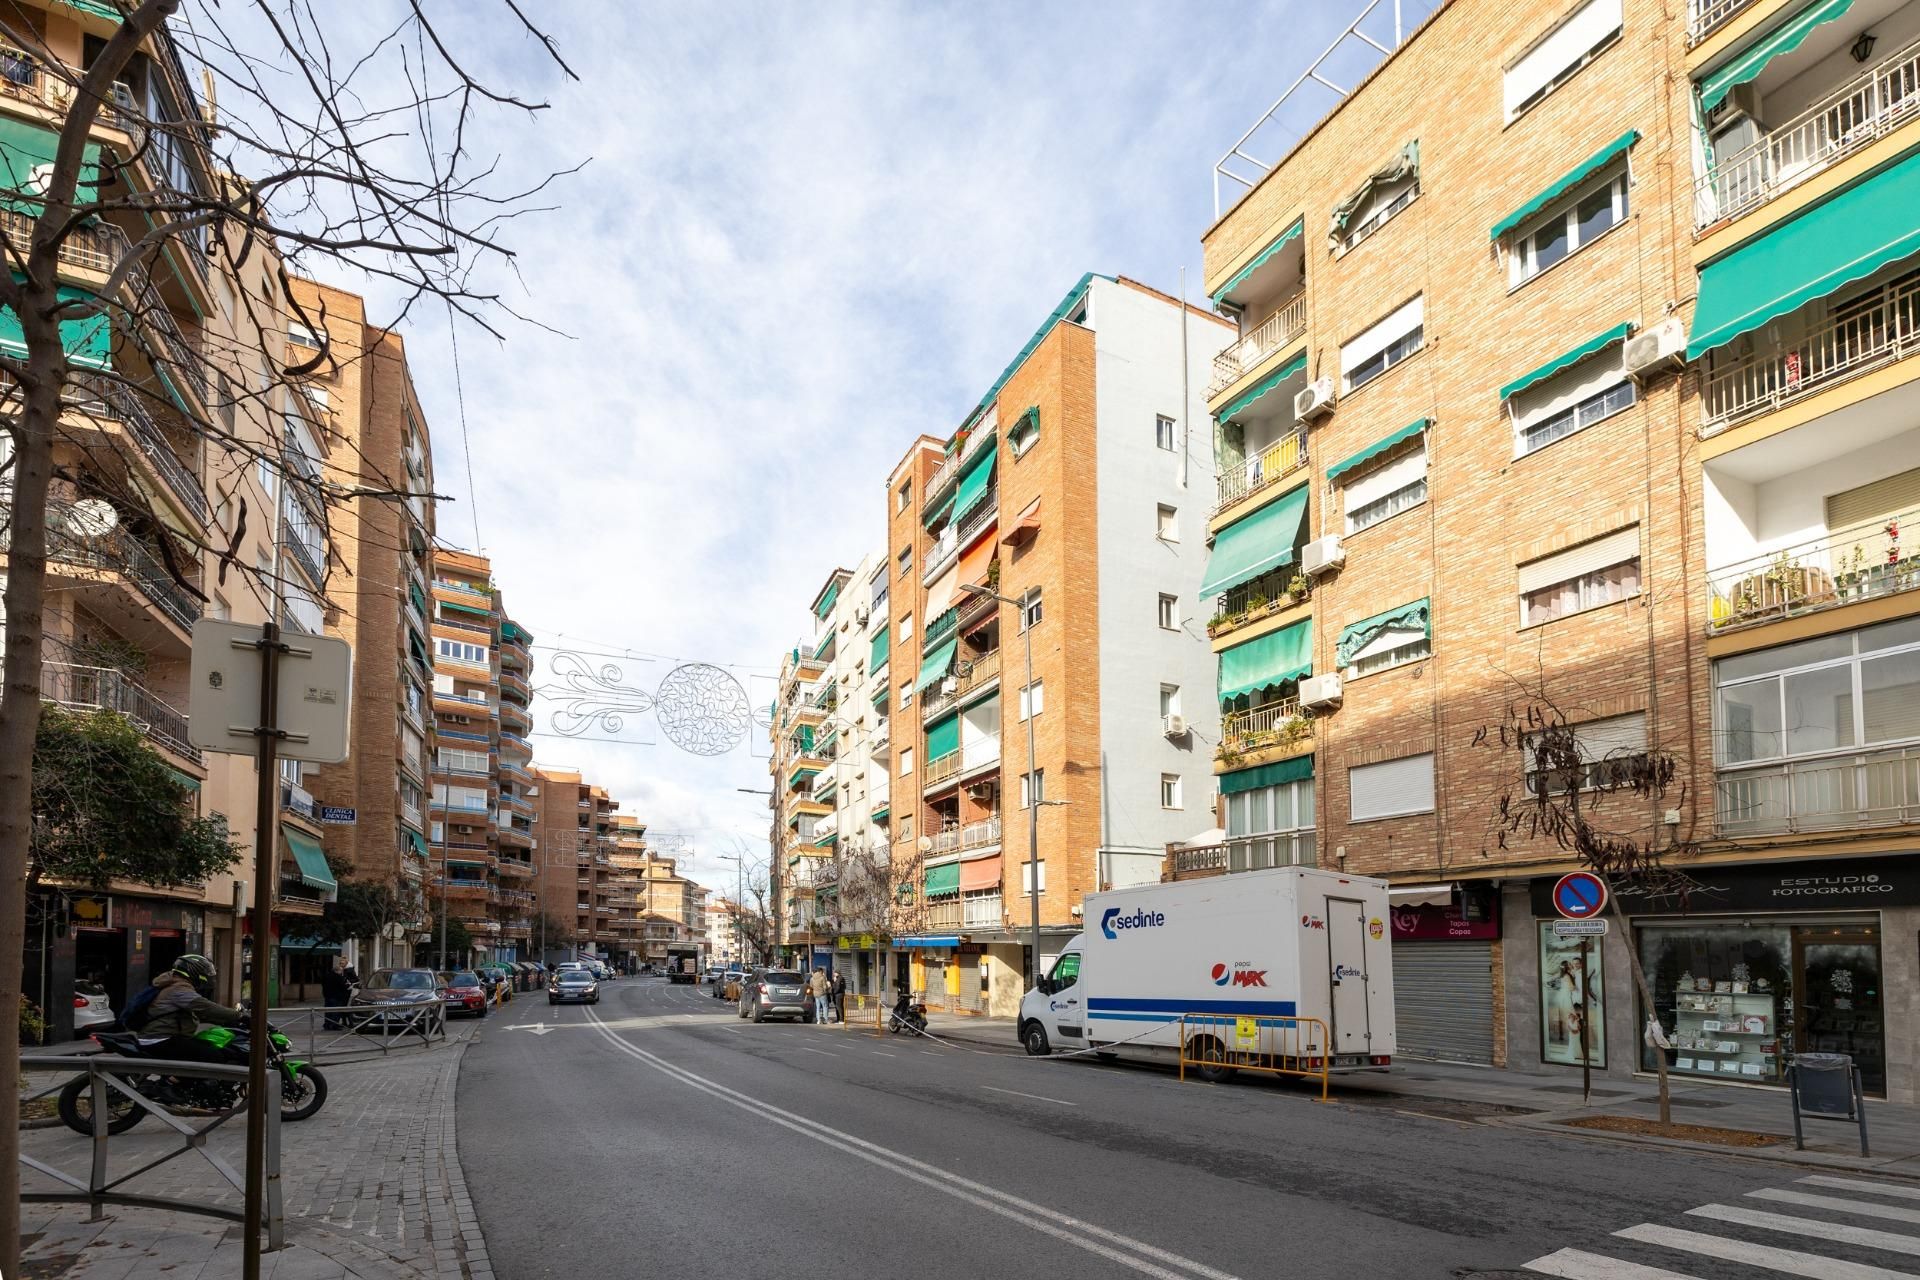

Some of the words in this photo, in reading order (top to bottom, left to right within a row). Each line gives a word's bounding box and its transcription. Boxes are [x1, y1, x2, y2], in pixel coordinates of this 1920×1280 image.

[1780, 874, 1880, 886] ESTUDIO
[1772, 884, 1894, 896] FOTOGRAFICO
[1117, 907, 1165, 930] sedinte
[1390, 908, 1421, 933] Rey
[1449, 928, 1471, 936] Copas
[1232, 970, 1268, 988] MAX
